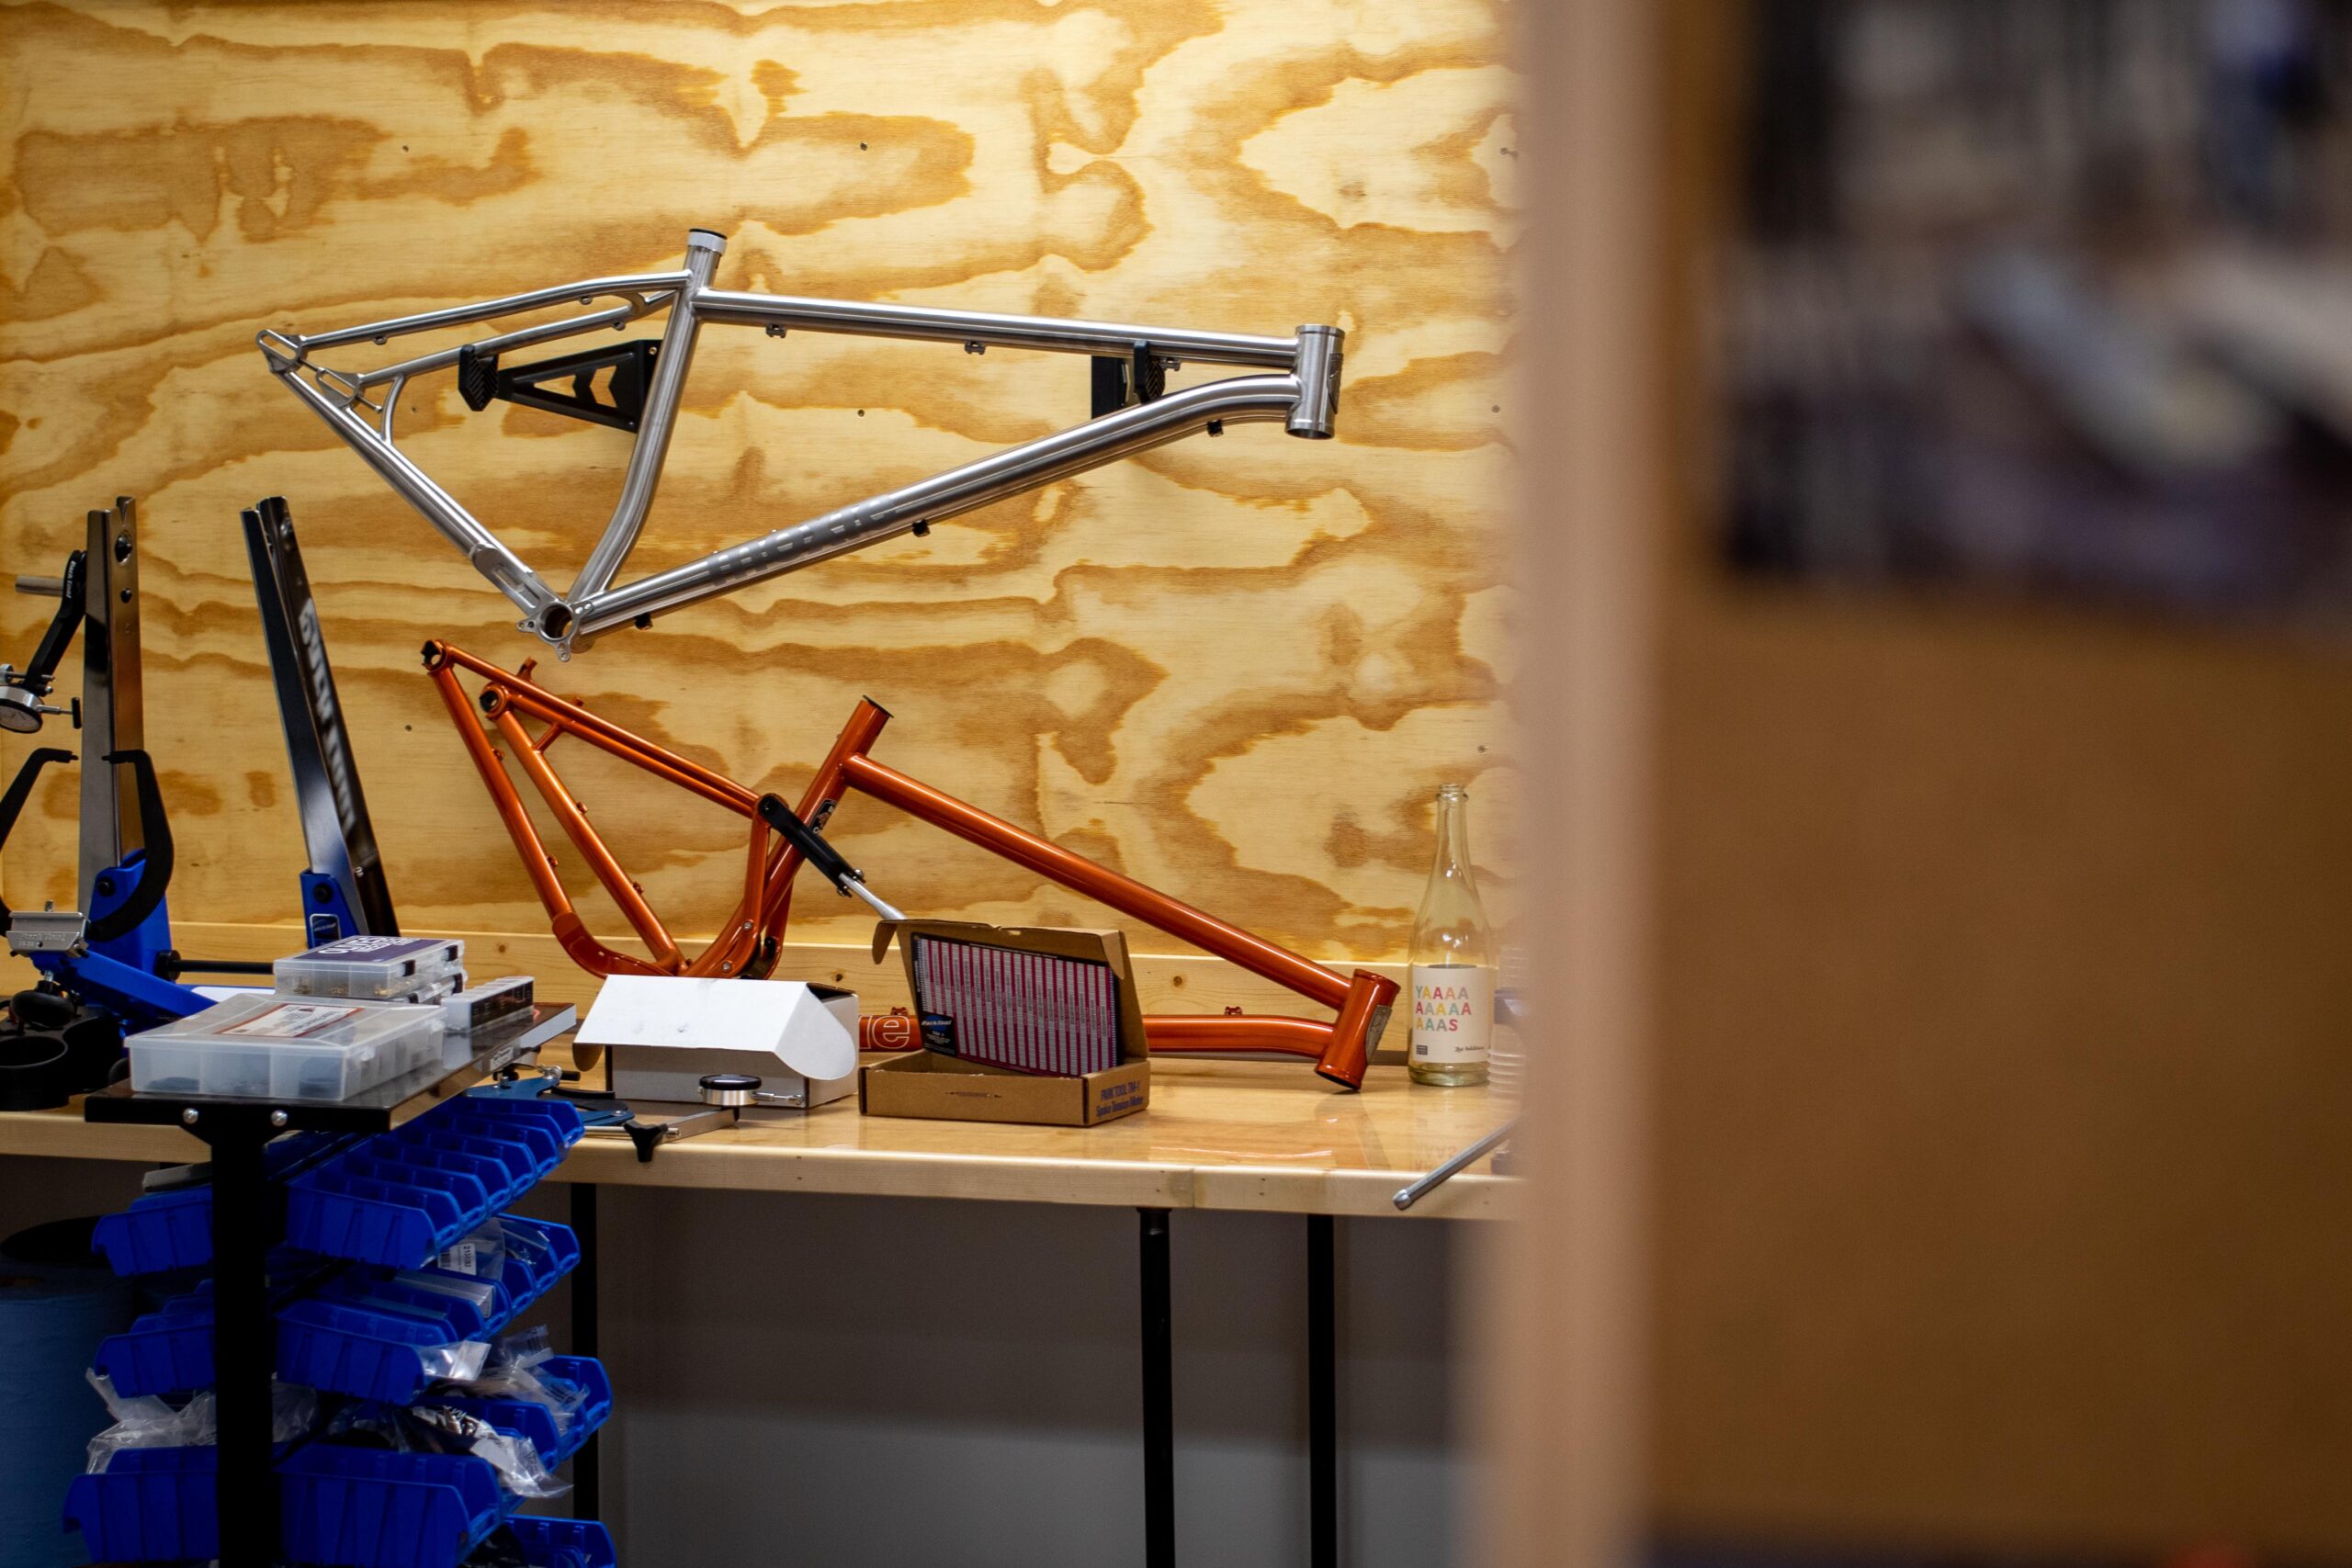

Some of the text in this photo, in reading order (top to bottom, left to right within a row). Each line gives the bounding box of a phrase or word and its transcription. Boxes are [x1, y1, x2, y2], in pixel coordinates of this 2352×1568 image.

[1416, 985, 1469, 999] YAAAA
[1416, 1001, 1472, 1015] AAAAA
[1416, 1017, 1458, 1032] AAAS
